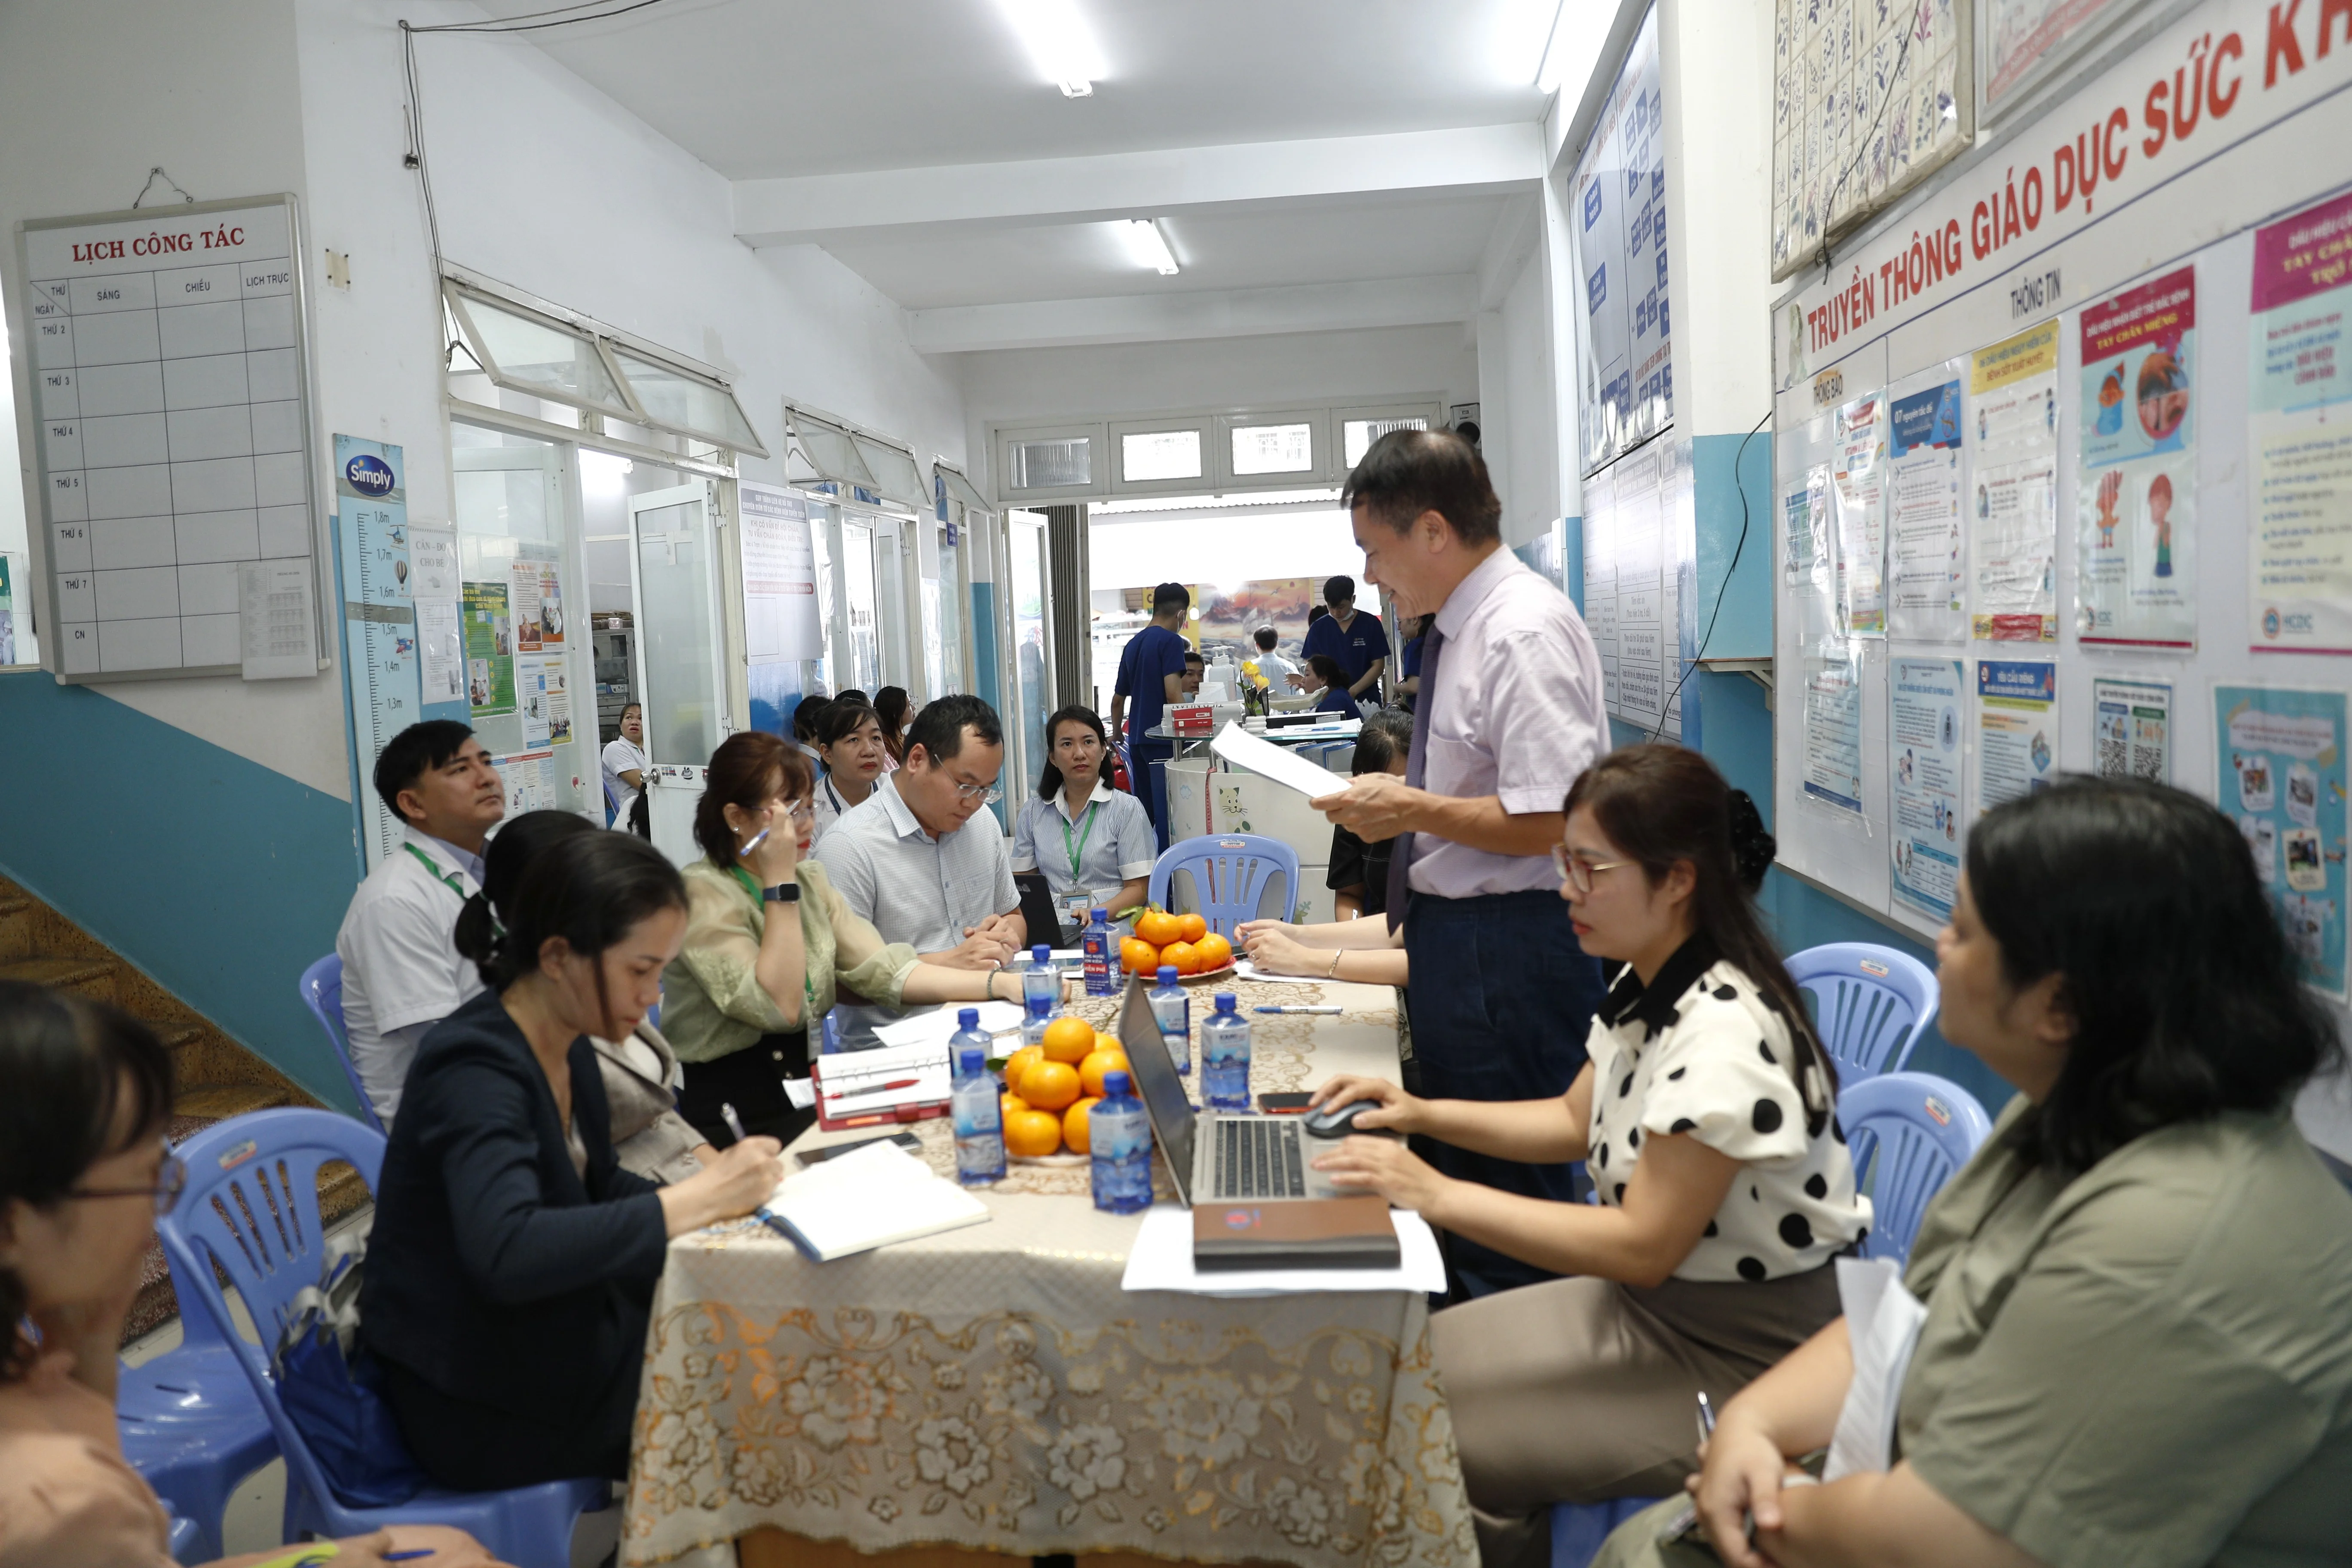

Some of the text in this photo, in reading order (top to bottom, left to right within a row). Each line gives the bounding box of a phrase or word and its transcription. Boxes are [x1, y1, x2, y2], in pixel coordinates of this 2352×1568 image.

[1808, 265, 1874, 354] TRUYỀN
[1880, 218, 1962, 312] THÔNG
[1971, 165, 2043, 261] GIÁO
[2054, 107, 2128, 215] DỤC
[2142, 32, 2243, 159] SỨC
[73, 224, 245, 265] LỊCH CÔNG TÁC
[246, 273, 289, 288] LỊCH TRỰC
[51, 285, 66, 296] THỨ
[97, 289, 120, 301] SÁNG
[2011, 268, 2061, 319] THÔNG TIN
[35, 305, 55, 315] NGÀY
[42, 323, 65, 335] THỨ 2
[47, 375, 70, 386] THỨ 3
[1814, 371, 1843, 406] THÔNG BÁO
[1895, 409, 1903, 423] 07
[53, 426, 73, 437] THỨ 4
[56, 477, 78, 489] THỨ 5
[351, 464, 391, 490] Simply
[374, 511, 389, 524] 1,8m
[759, 519, 765, 528] CÓ
[61, 527, 83, 539] THỨ 6
[416, 539, 446, 551] CÂN ĐO
[377, 549, 392, 562] 1,7m
[420, 557, 444, 567] CHO BÉ
[66, 578, 86, 590] THỨ 7
[379, 586, 395, 598] 1,6m
[75, 631, 85, 639] CN
[382, 624, 398, 636] 1,5m
[385, 661, 400, 672] 1,4m
[388, 698, 402, 710] 1,3m
